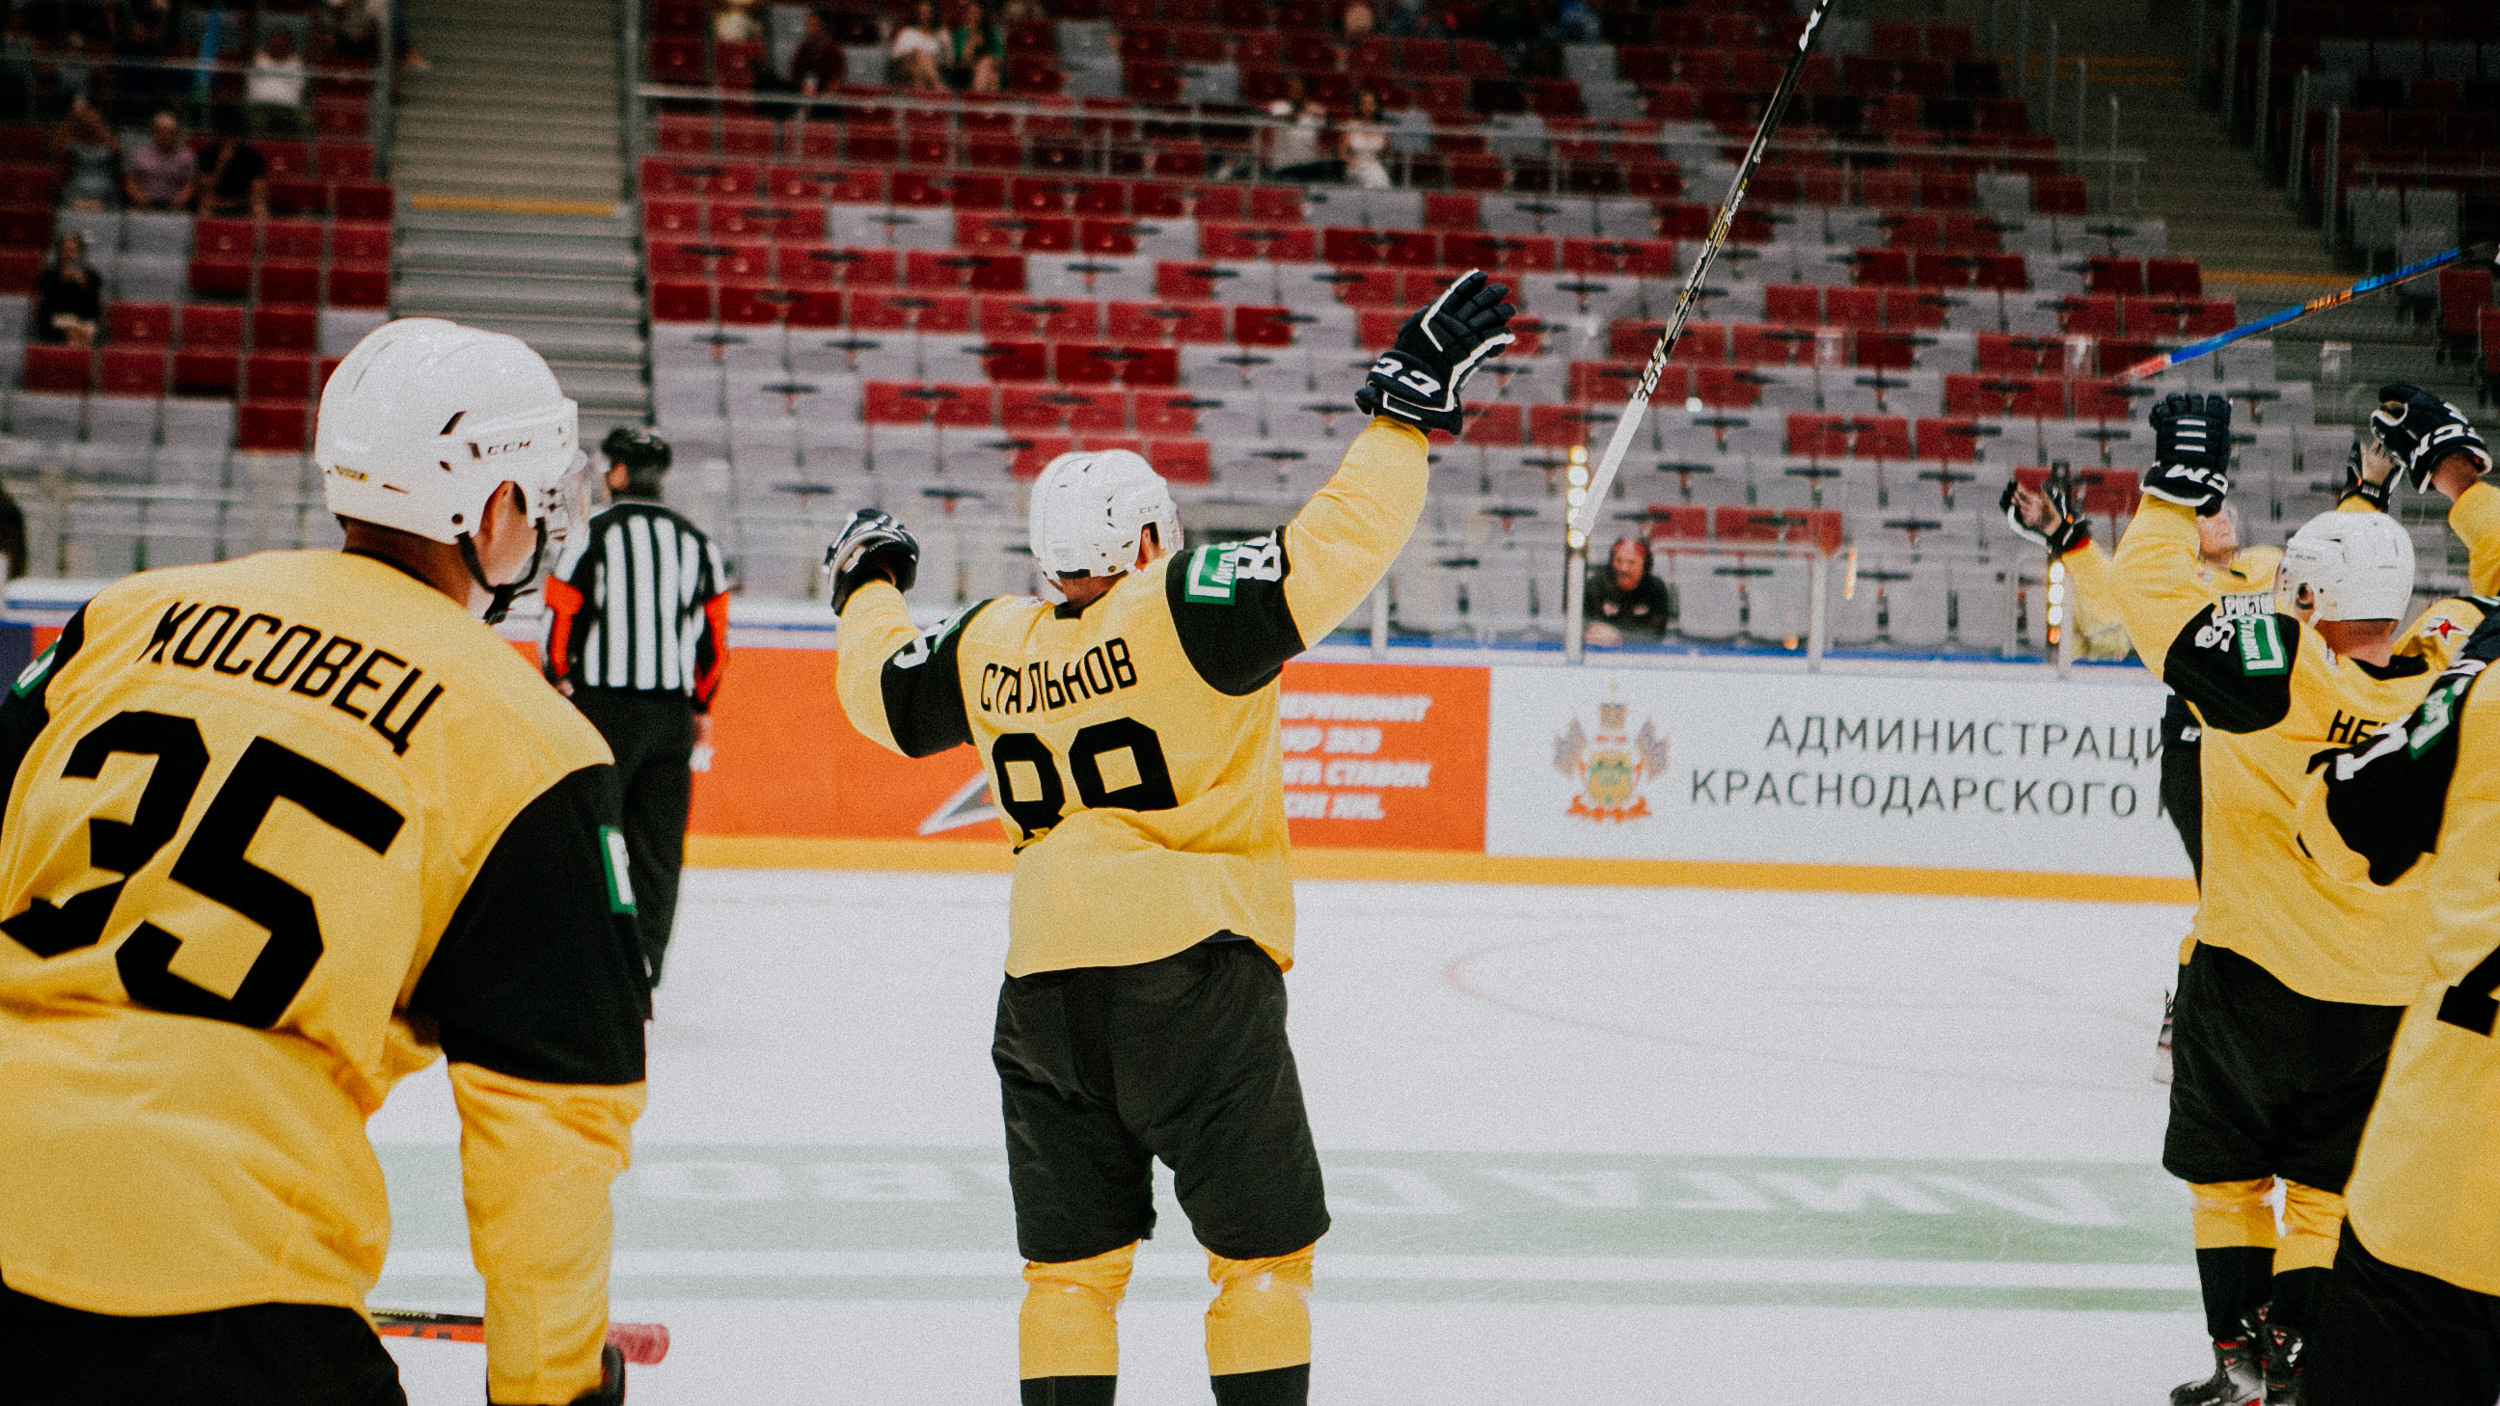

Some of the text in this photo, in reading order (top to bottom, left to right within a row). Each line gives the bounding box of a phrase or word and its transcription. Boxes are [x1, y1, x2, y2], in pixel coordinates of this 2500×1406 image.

[1371, 357, 1442, 398] CC
[487, 440, 532, 456] CCM
[2165, 464, 2229, 496] CM
[134, 601, 446, 758] КОСОВЕЦ
[980, 637, 1138, 715] СТАЛЬНОВ
[1764, 714, 2164, 768] АДМИНИСТРАЦИ
[1691, 768, 2137, 818] КРАСНОДАРСКОГО
[0, 711, 406, 1030] 35
